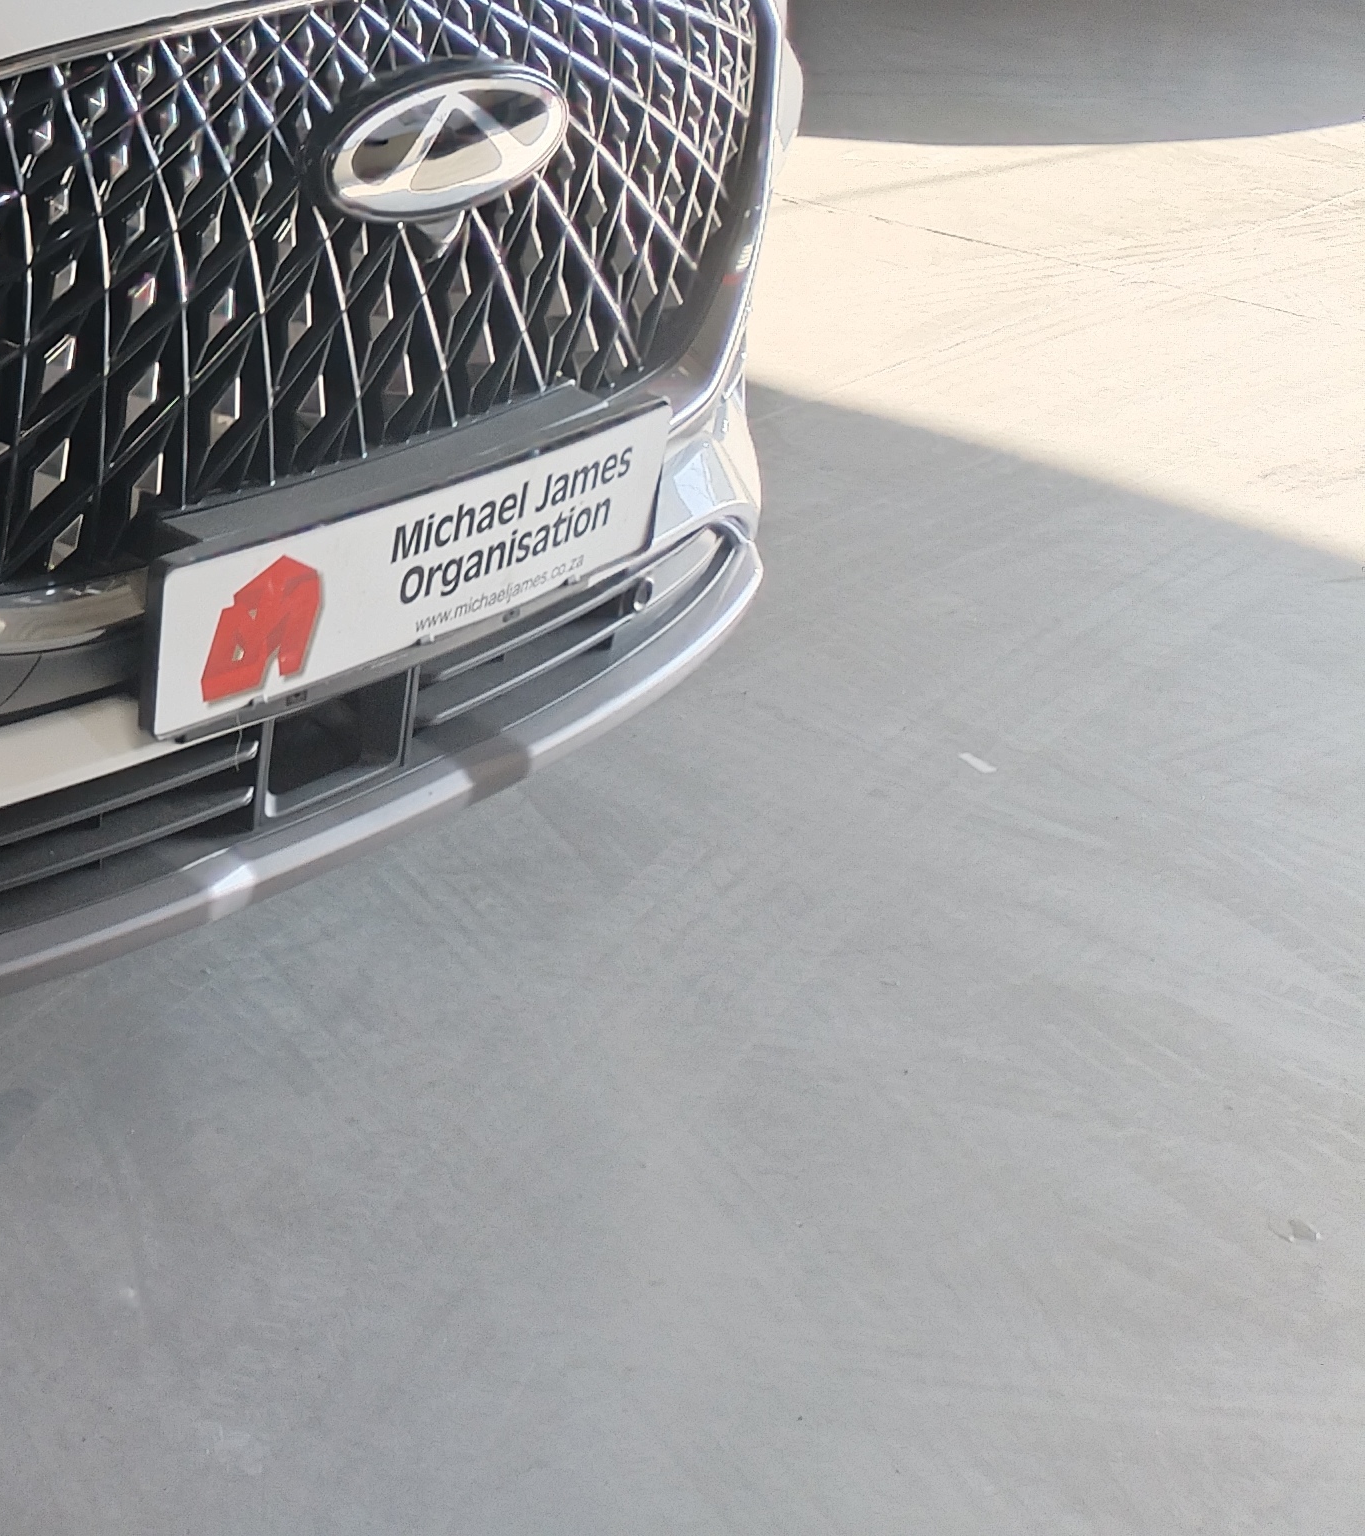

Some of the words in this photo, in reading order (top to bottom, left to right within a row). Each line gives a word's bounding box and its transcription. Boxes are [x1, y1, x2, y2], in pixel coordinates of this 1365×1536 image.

[390, 481, 530, 565] Michael
[535, 445, 633, 514] James
[399, 496, 611, 604] Organisation
[416, 554, 585, 632] www.michaeljames.co.za
